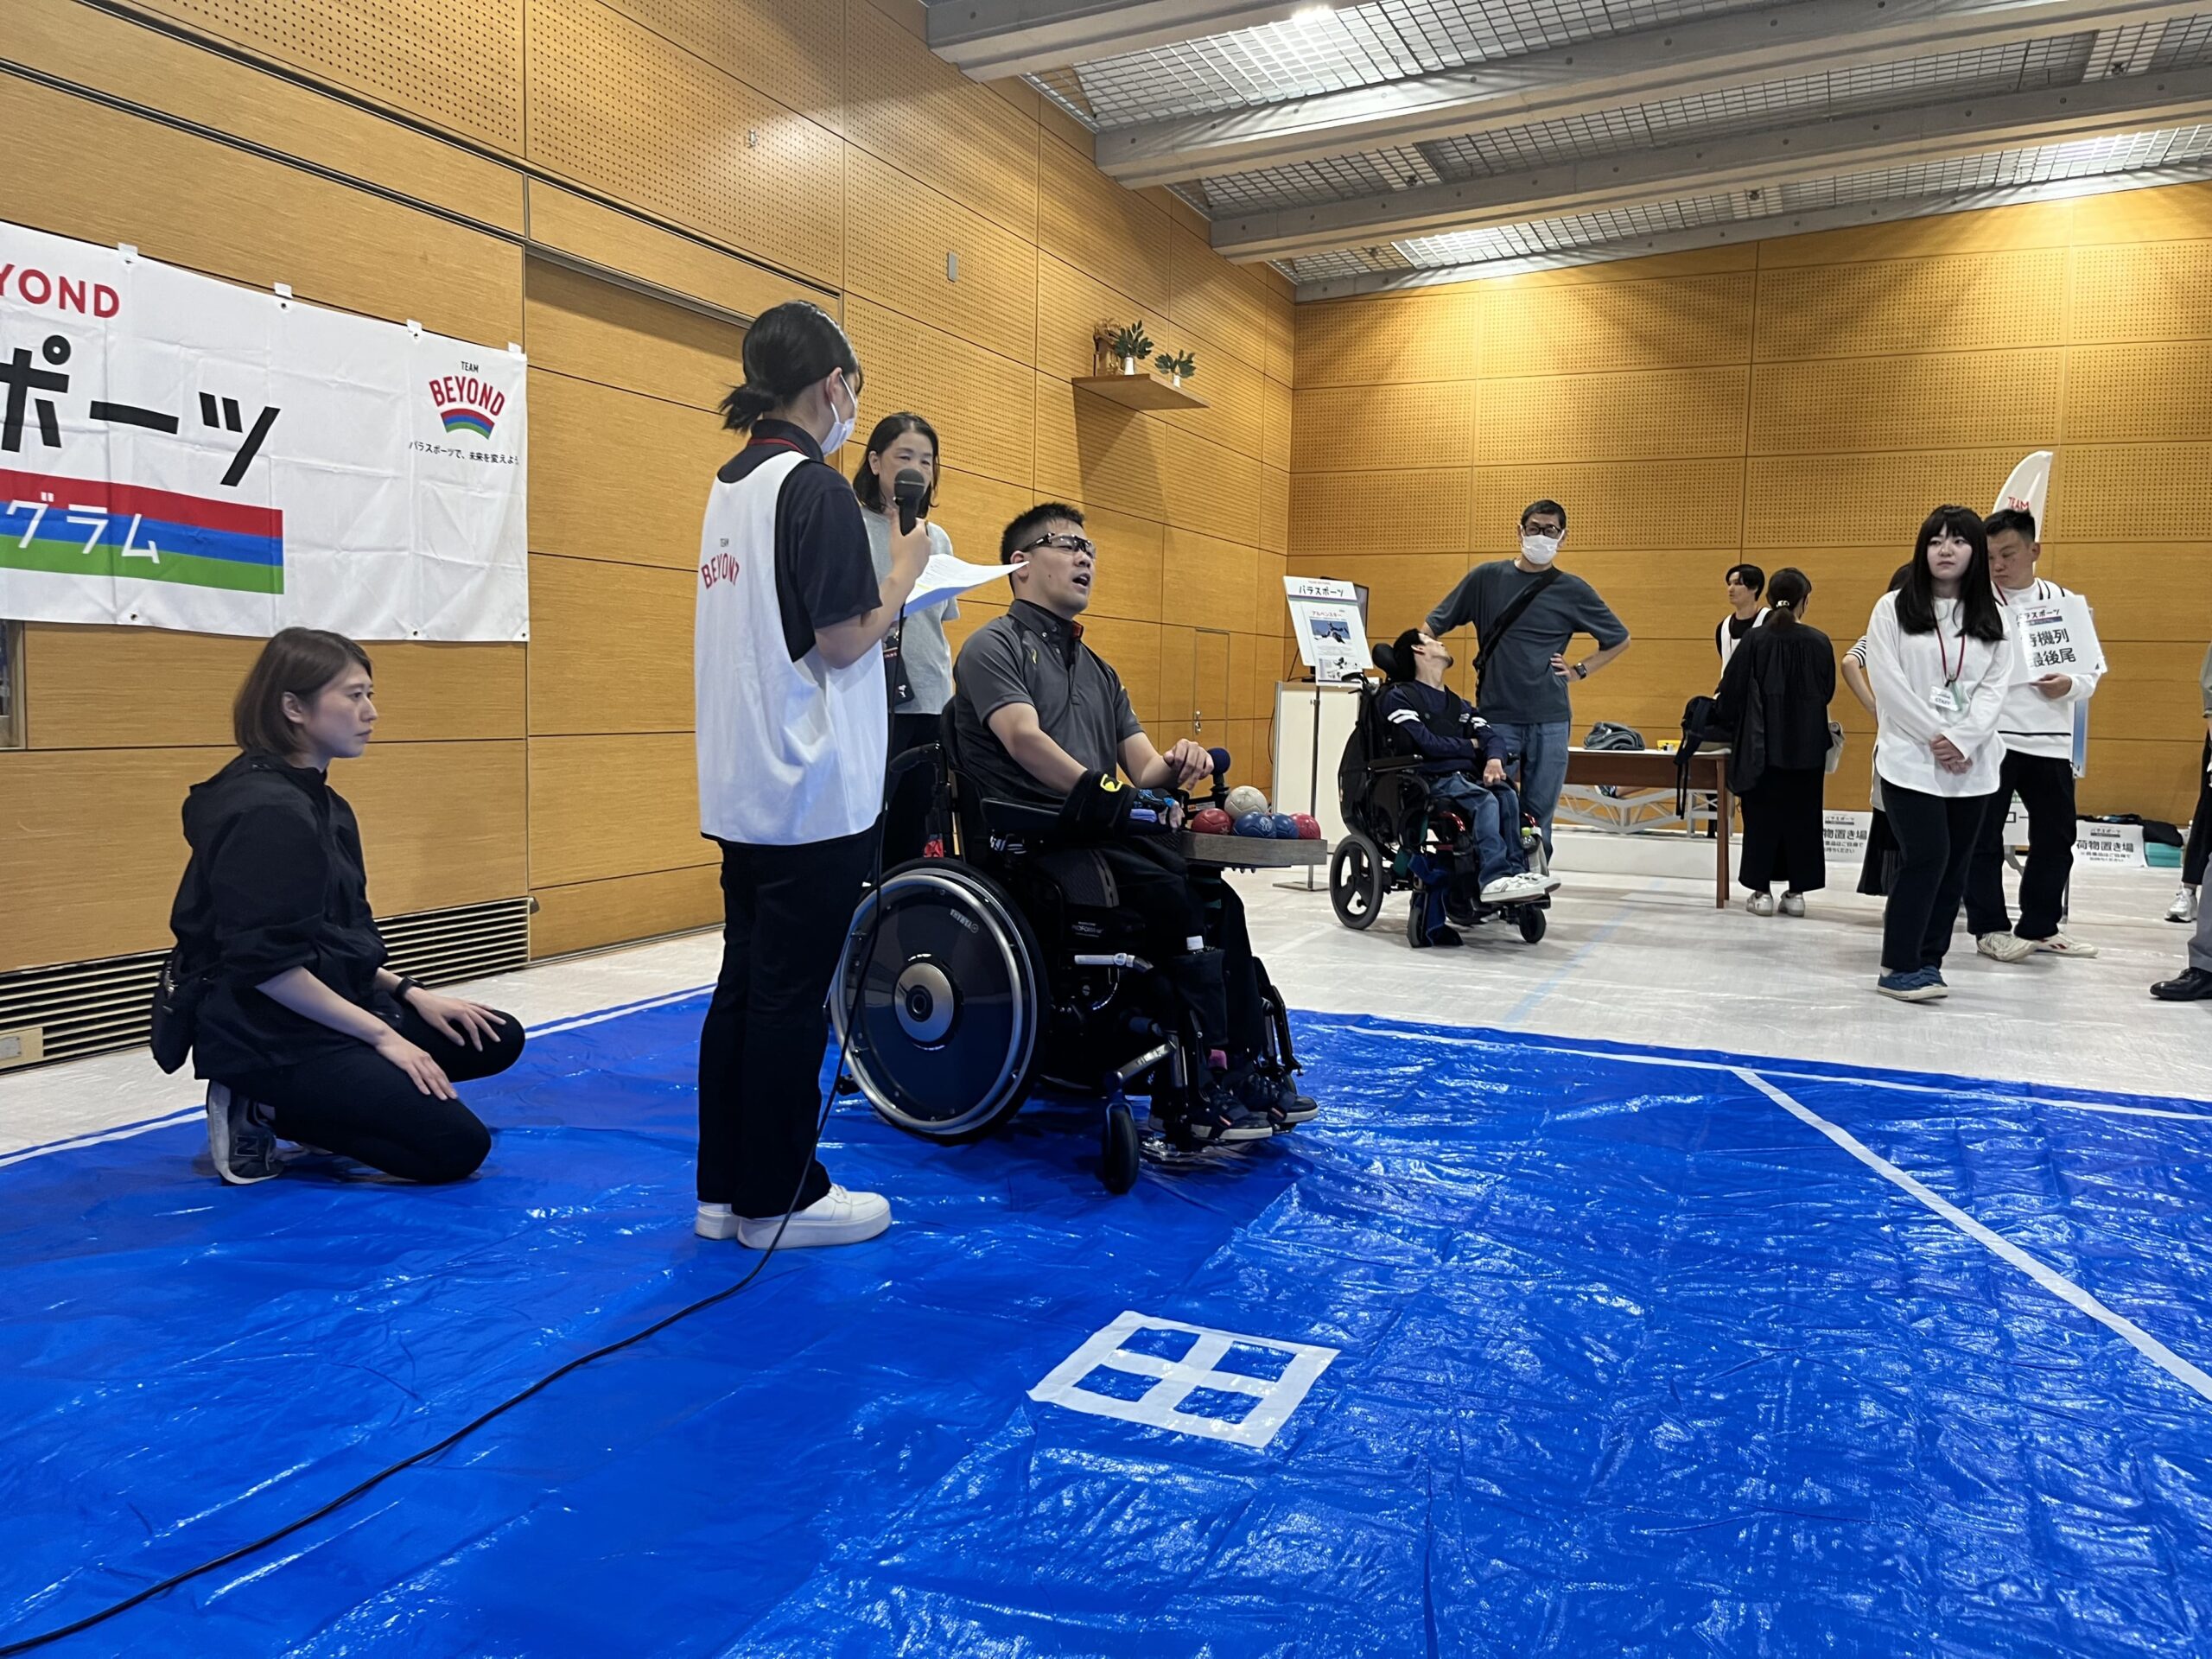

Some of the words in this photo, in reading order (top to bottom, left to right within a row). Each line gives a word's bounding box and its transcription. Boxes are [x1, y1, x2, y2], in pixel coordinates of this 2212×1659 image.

[461, 360, 480, 373] TEAM
[0, 334, 282, 488] ポーツ
[428, 375, 505, 417] BEYOND
[6, 491, 161, 564] グラム
[1299, 585, 1344, 597] パラスポーツ
